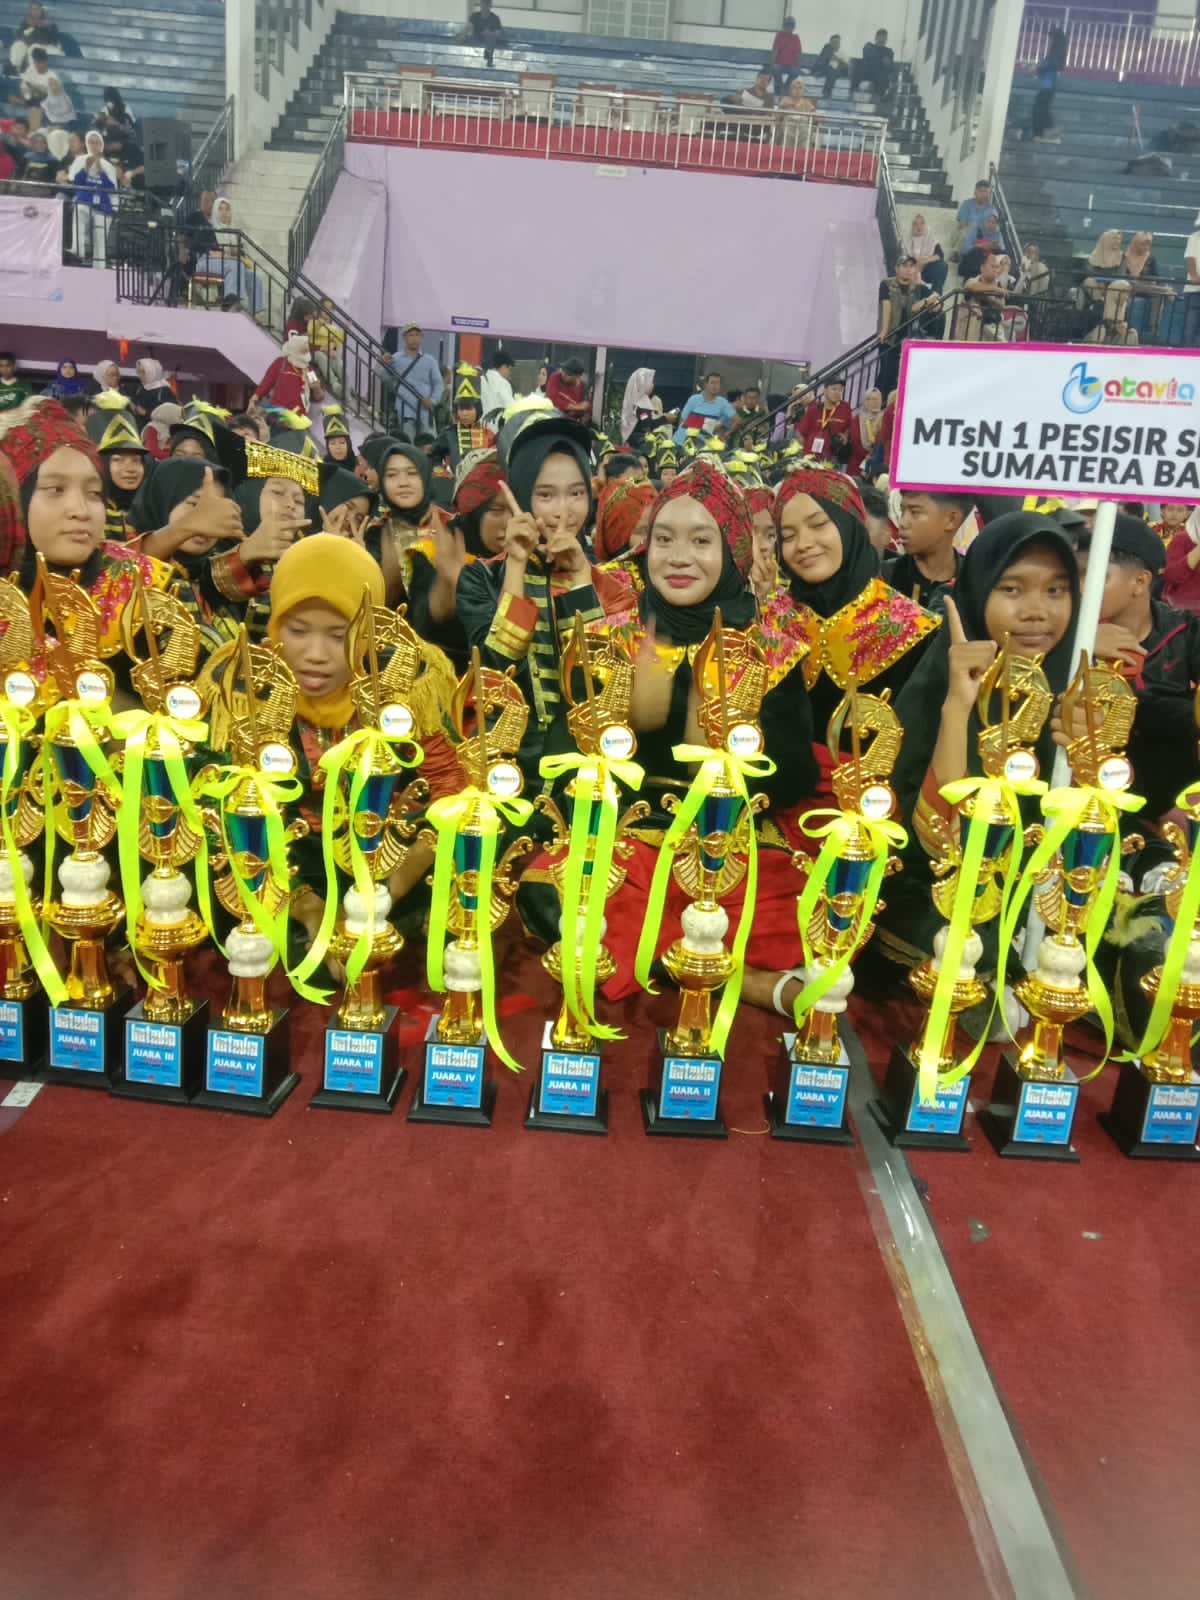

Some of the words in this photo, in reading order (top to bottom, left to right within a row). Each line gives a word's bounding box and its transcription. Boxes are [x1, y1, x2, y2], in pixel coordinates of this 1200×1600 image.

[913, 418, 1002, 448] MTsN
[1013, 422, 1028, 449] 1
[1039, 423, 1167, 456] PESISIR
[1175, 429, 1200, 458] S
[961, 451, 1144, 486] SUMATERA
[1154, 460, 1200, 489] BA
[213, 1058, 242, 1070] JUARA
[246, 1062, 256, 1071] IV
[332, 1057, 361, 1067] JUARA
[365, 1060, 374, 1069] III
[432, 1071, 461, 1081] JUARA
[465, 1073, 476, 1082] IV
[548, 1081, 578, 1091] JUARA
[581, 1083, 591, 1092] III
[669, 1086, 700, 1096] JUARA
[795, 1091, 825, 1102] JUARA
